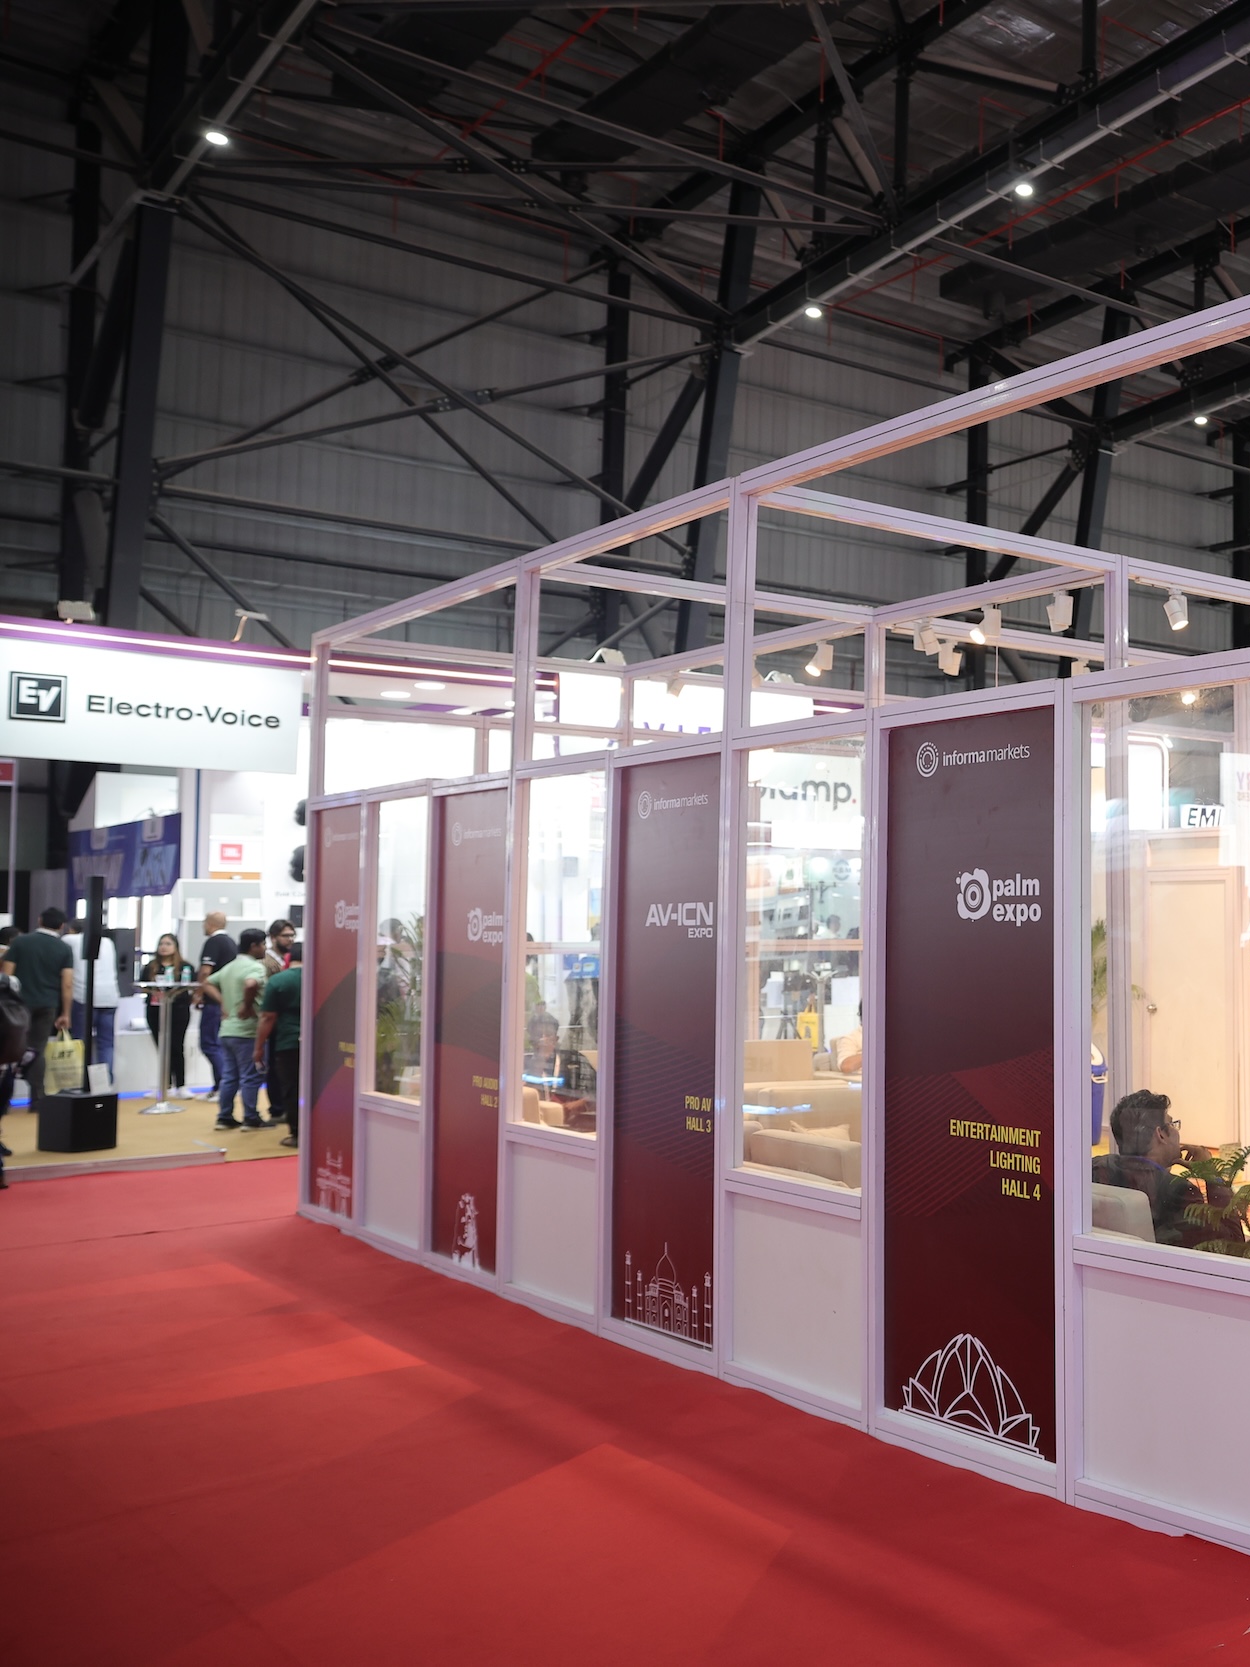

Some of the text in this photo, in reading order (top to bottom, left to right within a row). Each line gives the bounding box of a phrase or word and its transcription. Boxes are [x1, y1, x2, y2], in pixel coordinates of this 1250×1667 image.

[86, 694, 280, 729] Electro-Voice
[942, 743, 1030, 767] informamarkets
[654, 793, 709, 811] informamarkets
[992, 873, 1040, 900] palm
[483, 911, 503, 928] palm
[645, 902, 713, 927] AV-ICN
[993, 903, 1041, 927] expo
[482, 930, 503, 947] expo
[688, 928, 713, 939] EXPO
[685, 1095, 712, 1112] PRO AV
[685, 1116, 711, 1133] HALL 3
[949, 1118, 1041, 1148] ENTERTAINMENT
[989, 1150, 1041, 1175] LIGHTING
[1001, 1177, 1041, 1201] HALL 4
